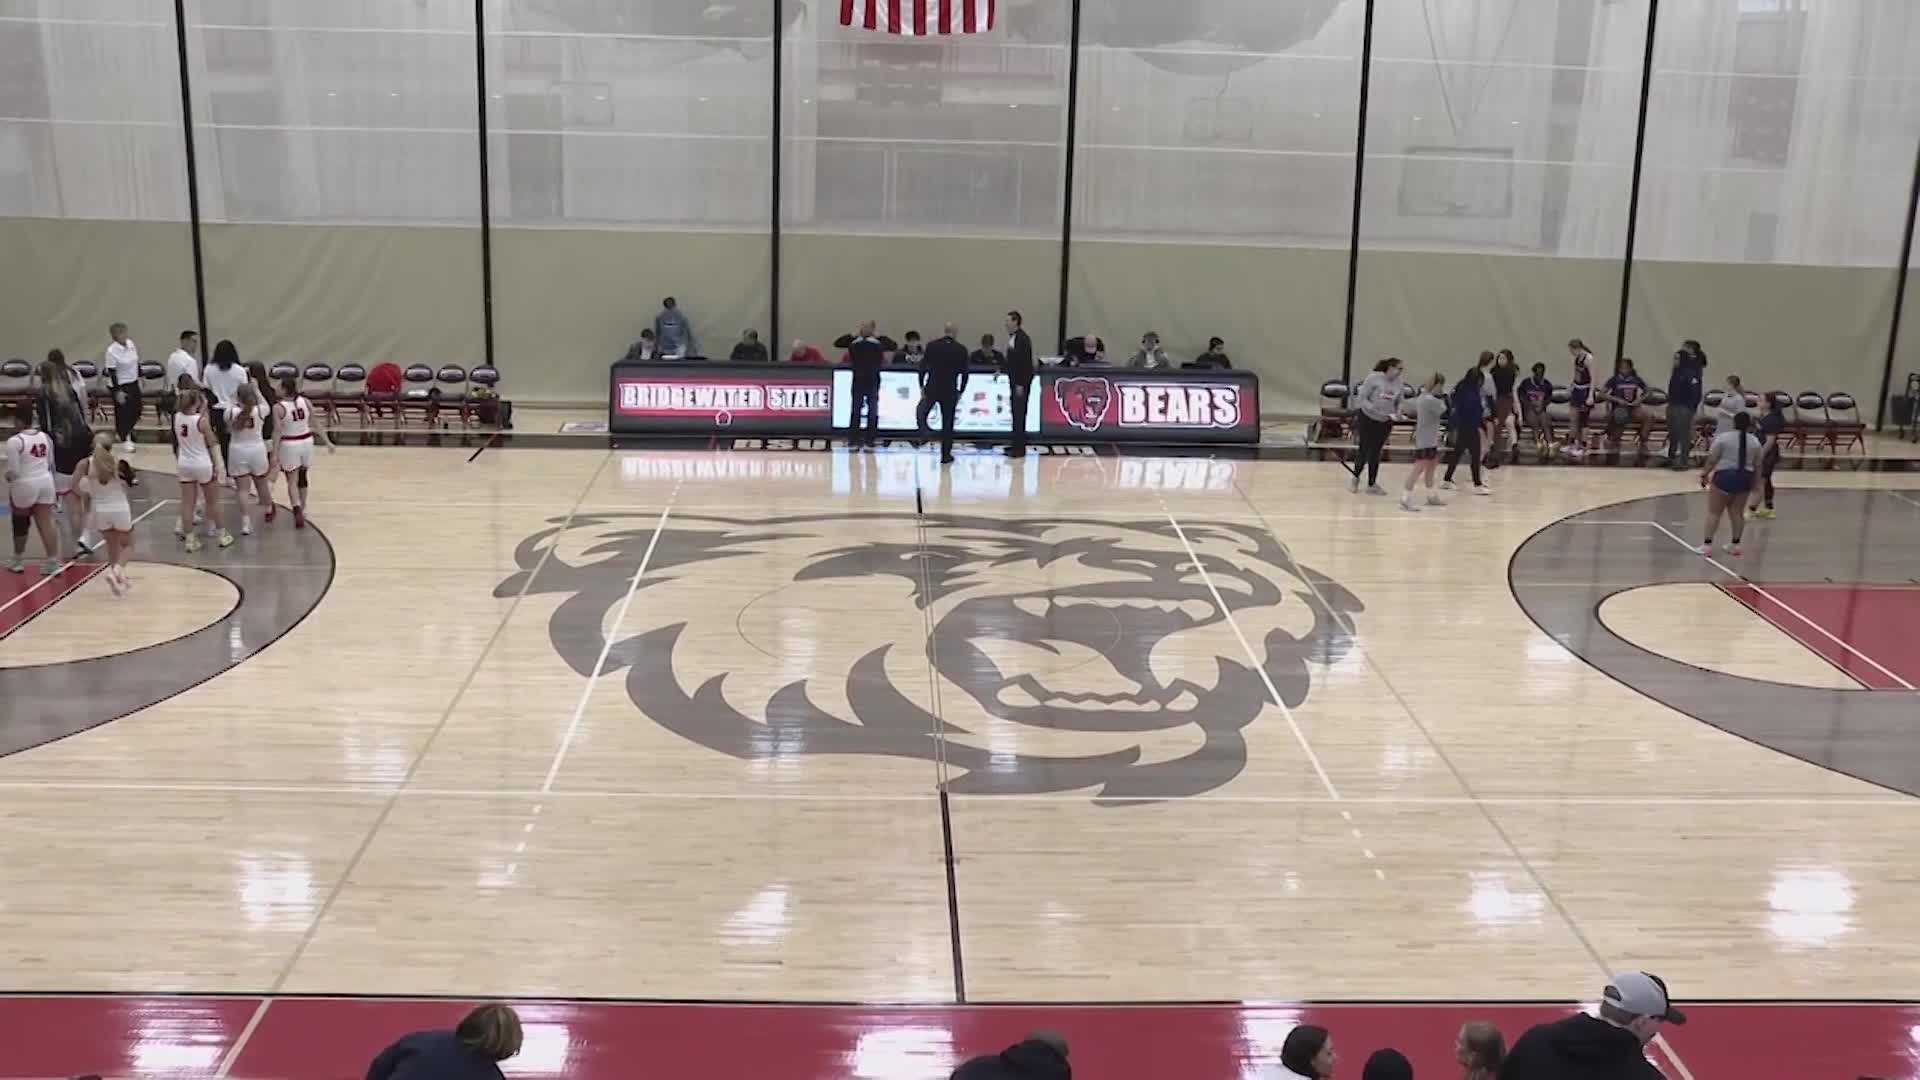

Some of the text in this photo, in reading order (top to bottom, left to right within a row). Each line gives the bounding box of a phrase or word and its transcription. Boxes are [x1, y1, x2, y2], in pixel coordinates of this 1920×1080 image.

[620, 384, 829, 410] BRIDGEWATER STATE
[1119, 385, 1237, 426] BEARS
[291, 407, 305, 421] 10
[30, 443, 47, 458] 42
